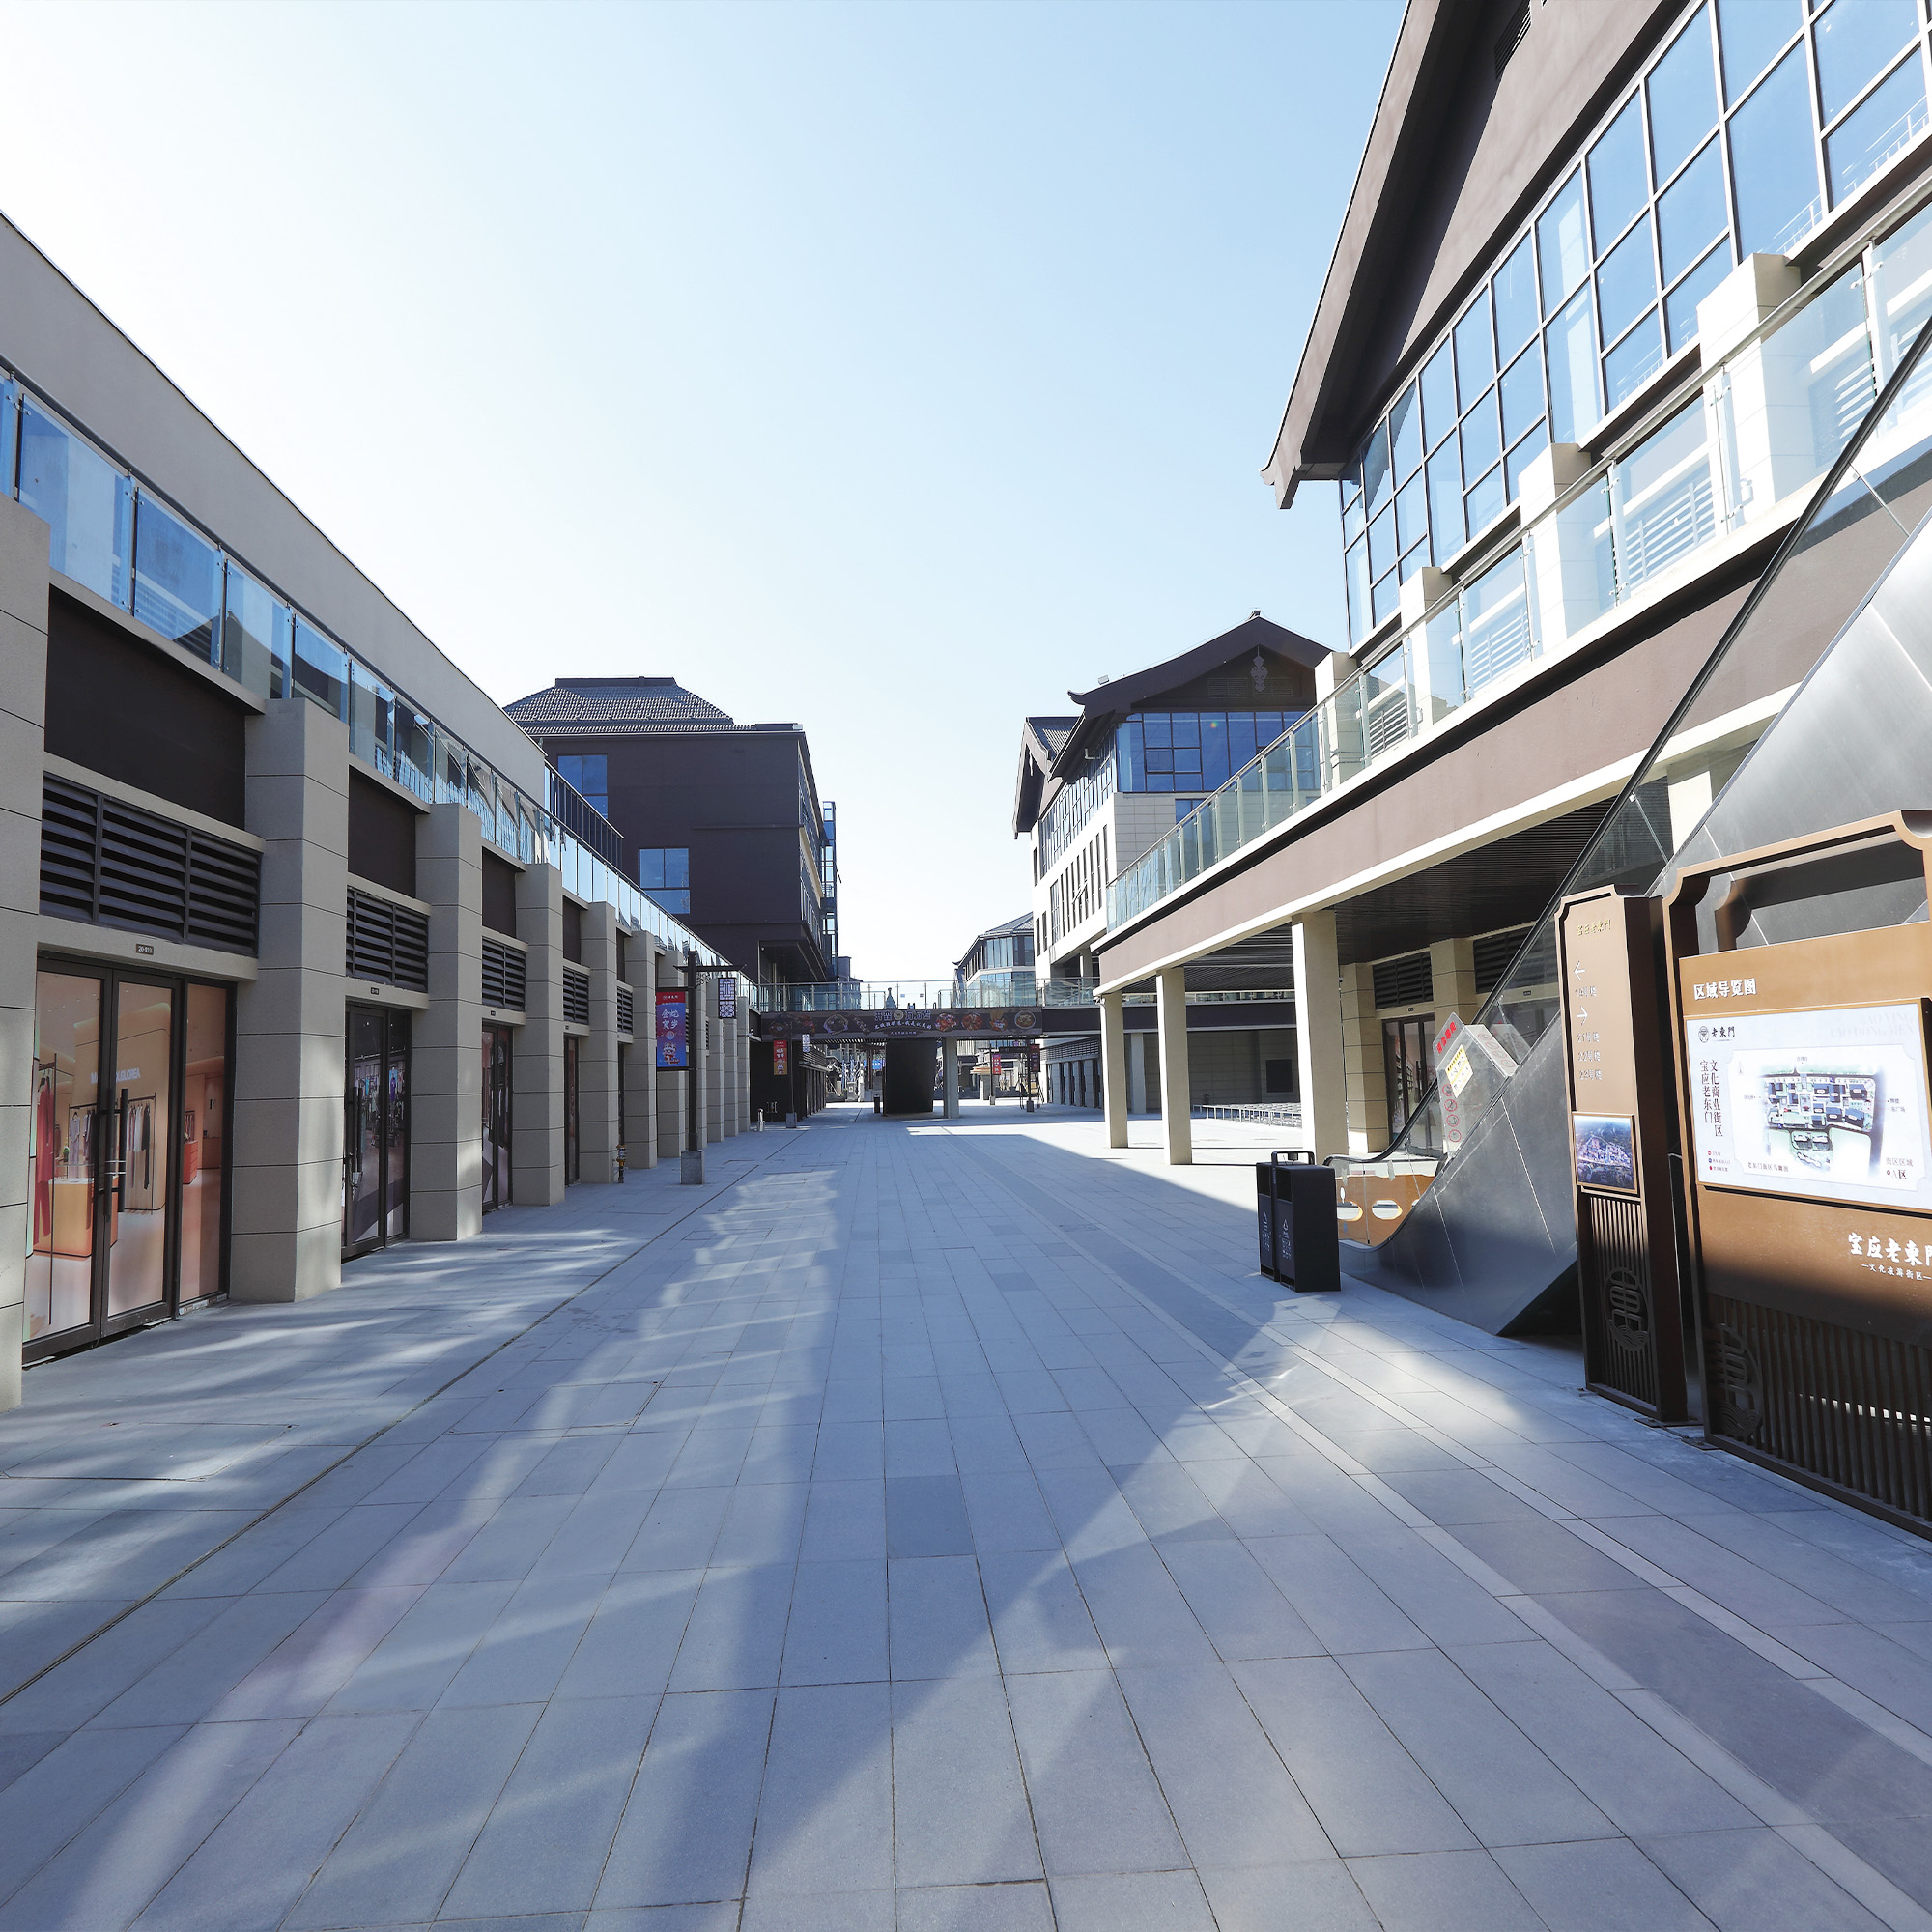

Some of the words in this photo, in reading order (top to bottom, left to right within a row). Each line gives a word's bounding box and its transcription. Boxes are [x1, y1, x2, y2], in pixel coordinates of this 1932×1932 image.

[1693, 978, 1756, 1001] 区域导览图
[1700, 1060, 1713, 1123] 宝应老东门
[1710, 1060, 1723, 1137] 文化商业街区
